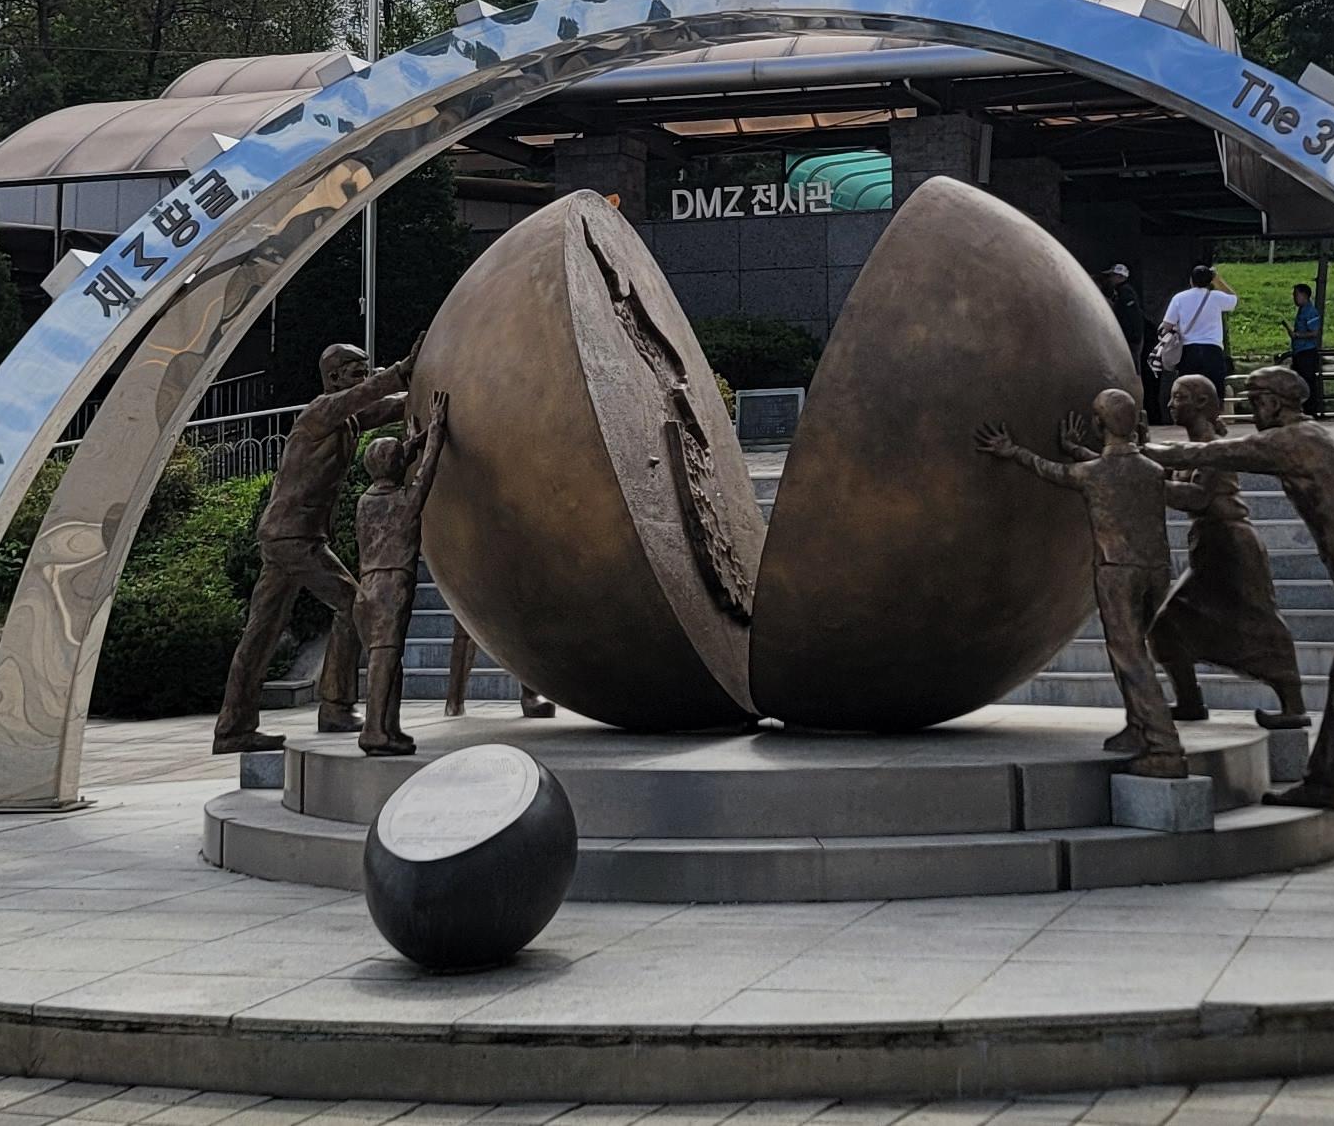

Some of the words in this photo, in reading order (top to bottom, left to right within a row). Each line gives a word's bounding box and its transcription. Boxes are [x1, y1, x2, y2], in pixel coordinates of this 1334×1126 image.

[1232, 69, 1301, 135] The
[671, 185, 746, 220] DMZ
[750, 180, 834, 216] 전시관
[82, 168, 240, 318] 제3땅굴
